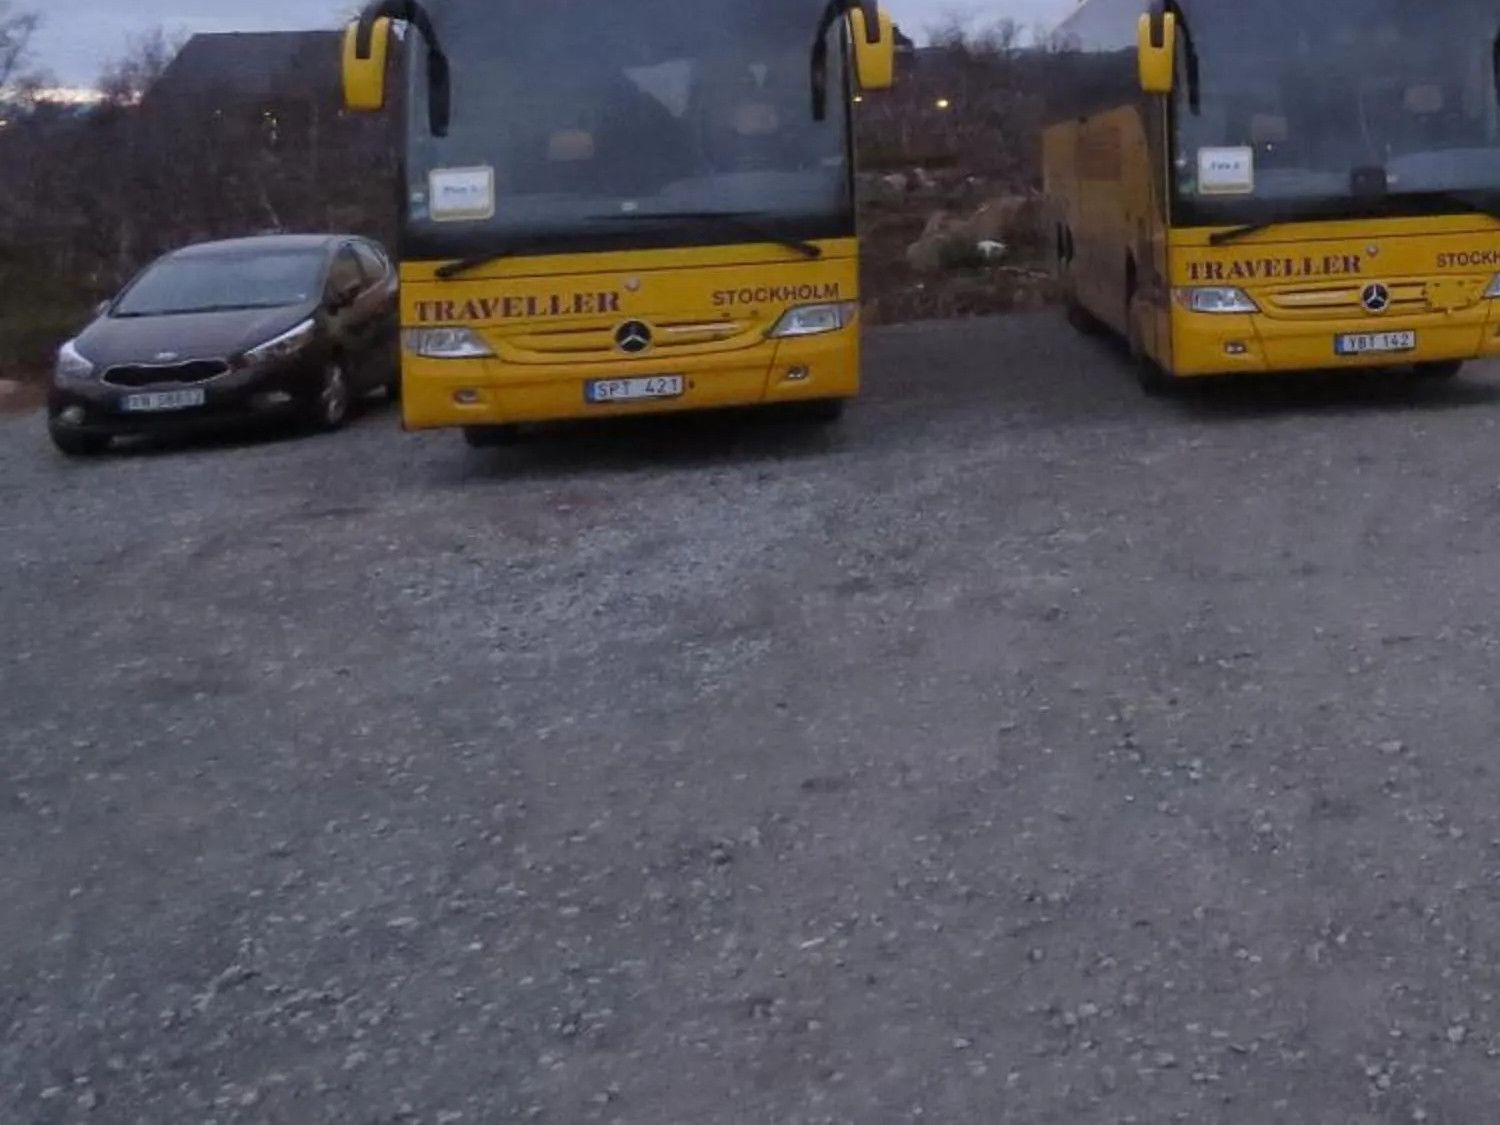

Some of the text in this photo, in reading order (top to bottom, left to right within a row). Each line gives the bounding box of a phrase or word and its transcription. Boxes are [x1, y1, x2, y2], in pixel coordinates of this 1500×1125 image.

[1187, 254, 1361, 280] TRAVELLER
[414, 291, 621, 322] TRAVELLER
[712, 282, 840, 306] STOCKHOLM
[597, 378, 679, 397] SPT 421
